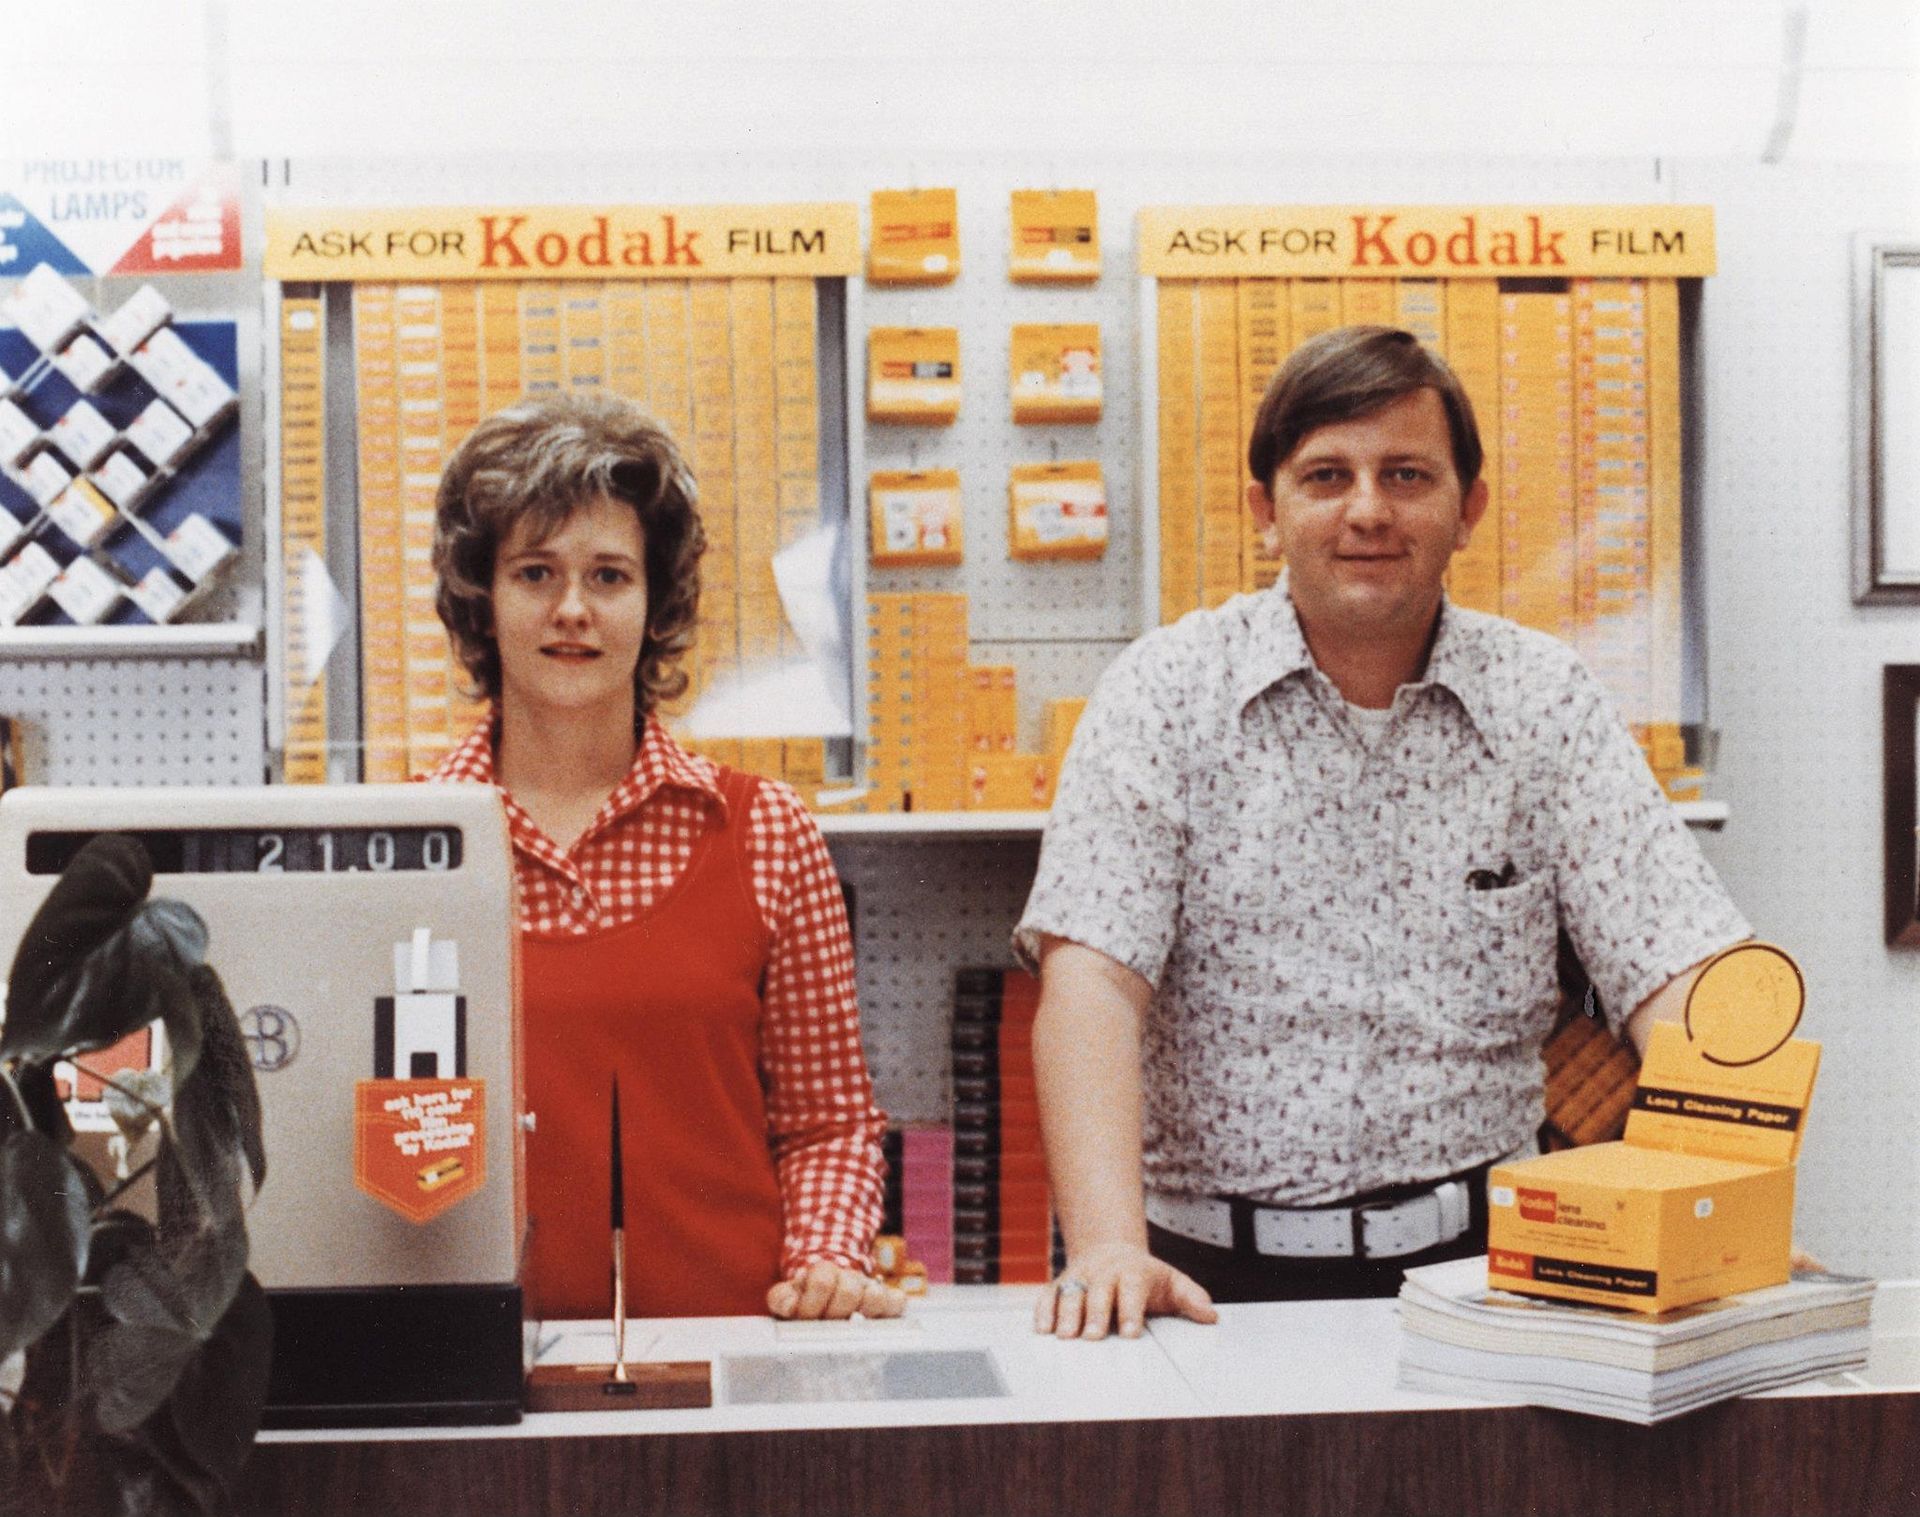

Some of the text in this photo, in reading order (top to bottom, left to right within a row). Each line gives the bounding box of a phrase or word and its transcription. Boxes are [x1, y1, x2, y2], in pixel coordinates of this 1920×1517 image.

[50, 190, 148, 221] LAMPS
[291, 215, 826, 268] ASK FOR Kodak FILM
[1167, 215, 1685, 267] ASK FOR Kodak FILM
[1646, 1094, 1790, 1124] Lens Cleaning Paper
[1538, 1265, 1564, 1278] Lens
[1566, 1270, 1613, 1286] Cleaning
[1615, 1276, 1650, 1289] Paper
